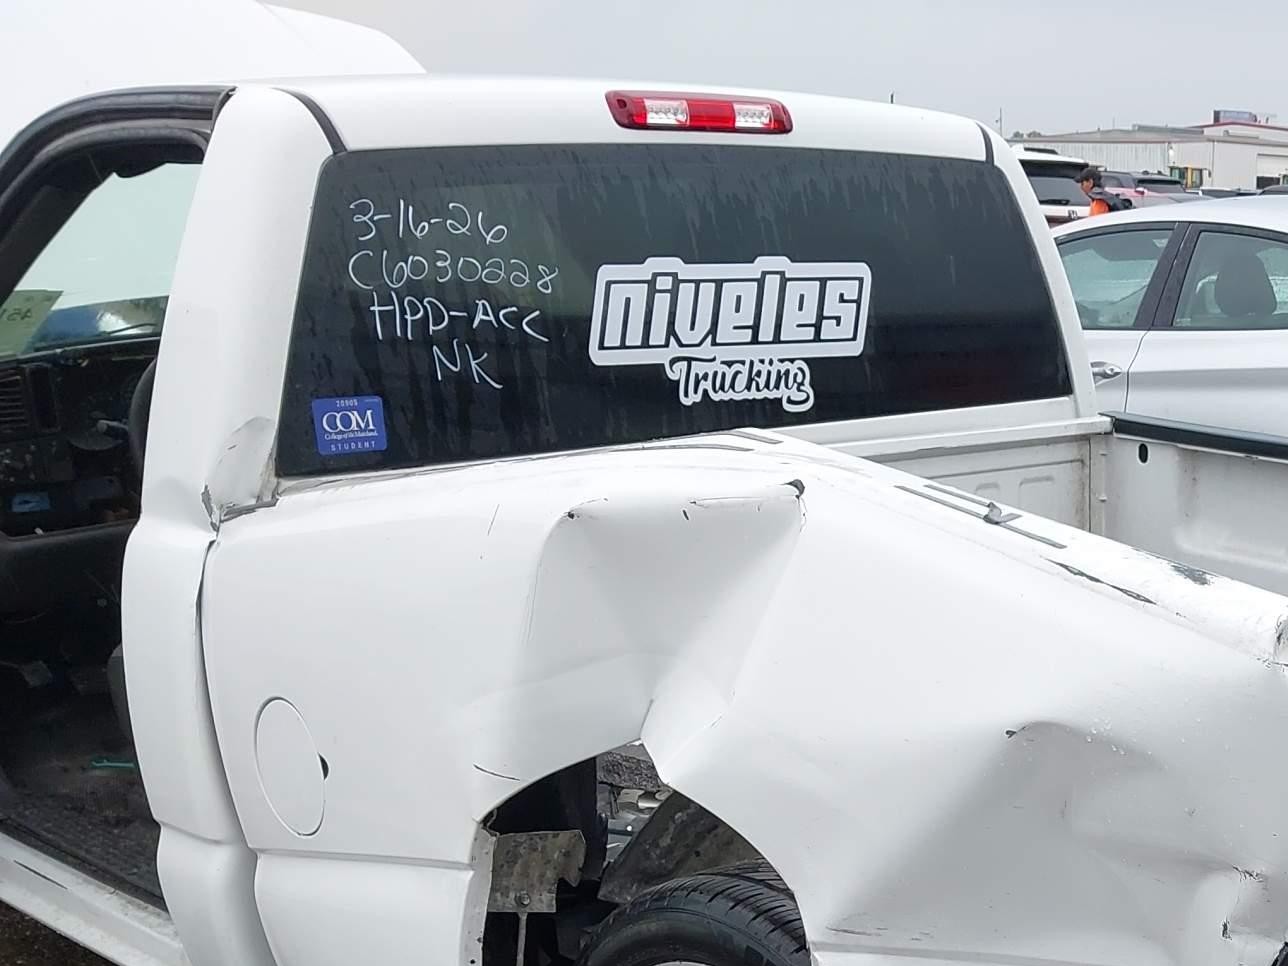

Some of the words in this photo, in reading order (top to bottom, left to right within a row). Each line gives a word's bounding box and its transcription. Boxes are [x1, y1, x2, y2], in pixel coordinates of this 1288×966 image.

[348, 198, 509, 245] 3-16-26
[348, 249, 559, 295] C6030228
[369, 290, 551, 341] HPD-ACC
[432, 338, 504, 389] NK
[669, 354, 811, 405] Trucking
[322, 409, 376, 433] COM
[330, 440, 376, 452] STUDENT
